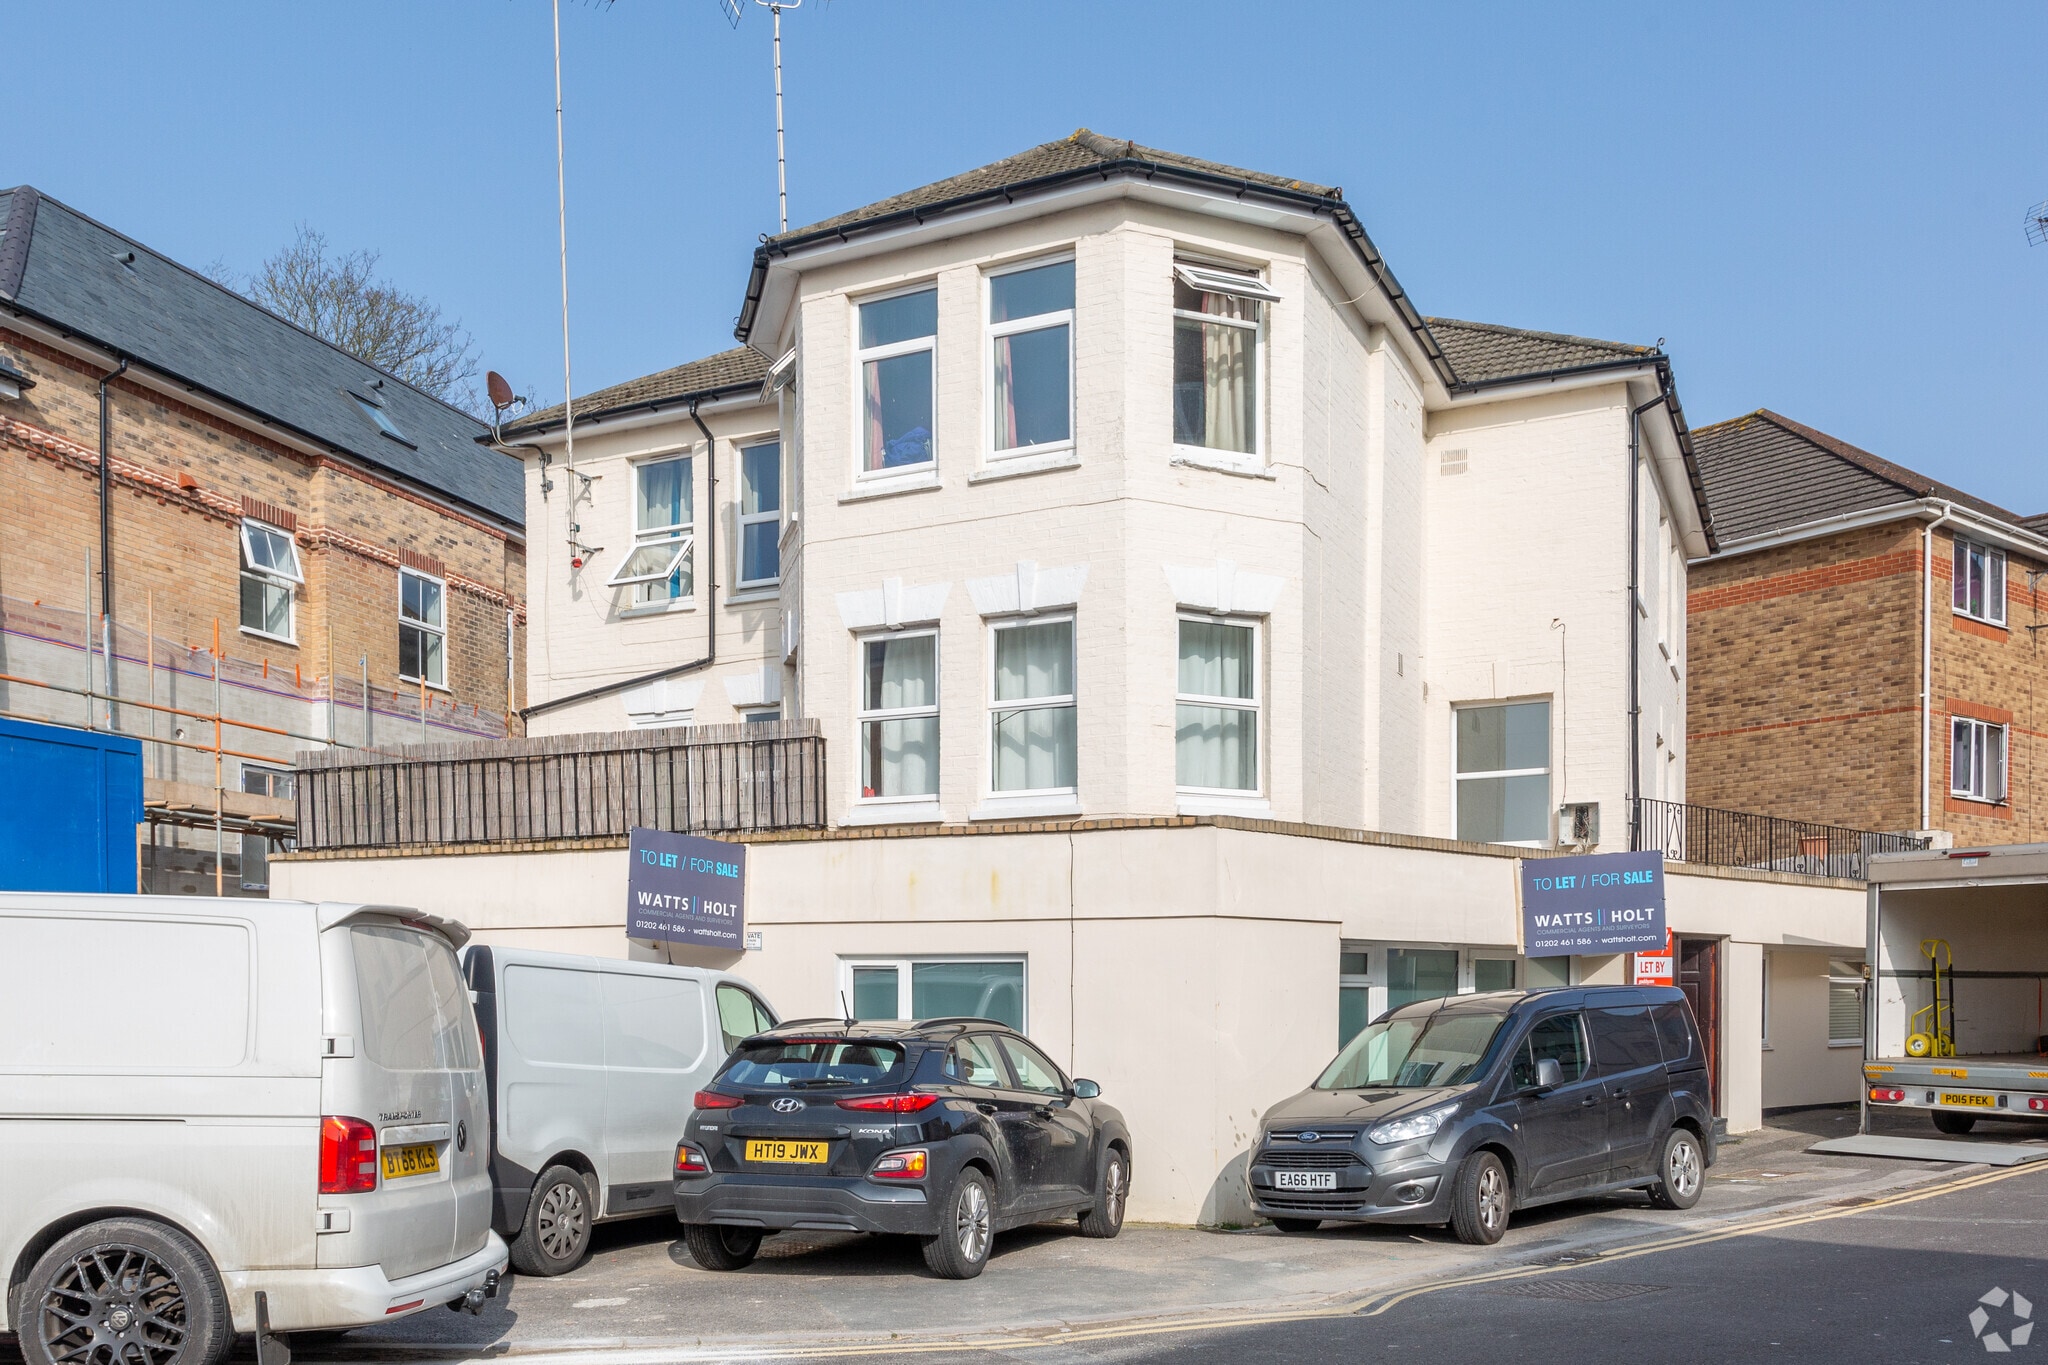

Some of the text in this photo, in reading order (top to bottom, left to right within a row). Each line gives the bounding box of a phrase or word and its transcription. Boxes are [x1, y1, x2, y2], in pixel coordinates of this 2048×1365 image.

[640, 849, 657, 865] TO
[660, 852, 679, 868] LET
[690, 858, 714, 874] FOR
[716, 862, 739, 878] SALE
[1533, 877, 1552, 891] TO
[1555, 876, 1576, 890] LET
[1591, 872, 1620, 887] FOR
[1623, 870, 1653, 884] SALE
[638, 891, 737, 917] WATTS HOLT
[638, 908, 674, 918] COMMERCIAL
[675, 912, 694, 921] AGENTS
[706, 917, 733, 926] SURVEYORS
[1534, 908, 1655, 927] WATTS HOLT
[636, 920, 737, 939] 01202 461 586 wattsholt.com
[1536, 928, 1577, 936] COMMERCIAL
[1616, 923, 1650, 931] SURVEYORS
[1535, 934, 1657, 947] 01202 461 586 wattsholt.com
[1640, 961, 1665, 973] LET BY
[1945, 1094, 1989, 1105] PO15 FEK
[385, 1147, 436, 1174] BT66 KLS
[754, 1143, 818, 1160] HT19 JWX
[1280, 1173, 1331, 1187] EA66 HTF
